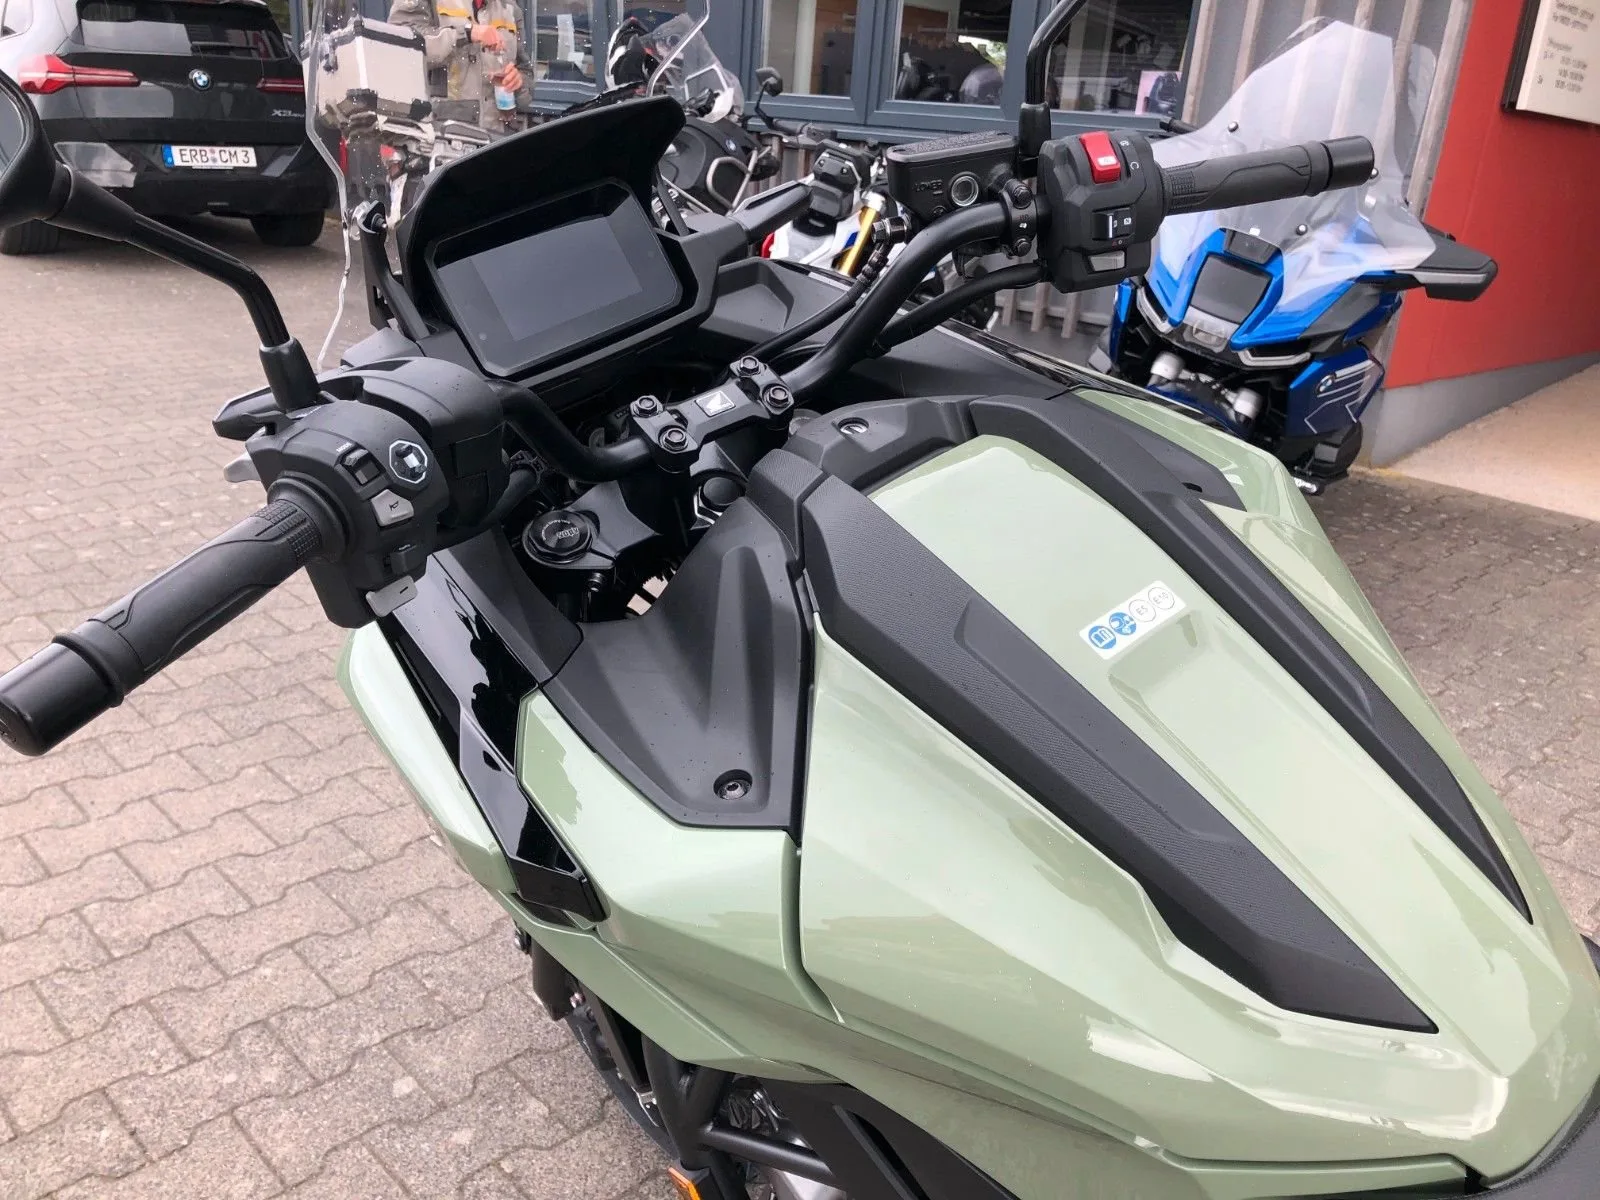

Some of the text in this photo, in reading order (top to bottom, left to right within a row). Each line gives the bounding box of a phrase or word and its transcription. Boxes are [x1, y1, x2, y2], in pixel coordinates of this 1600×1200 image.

[179, 148, 250, 164] ERB CM 3
